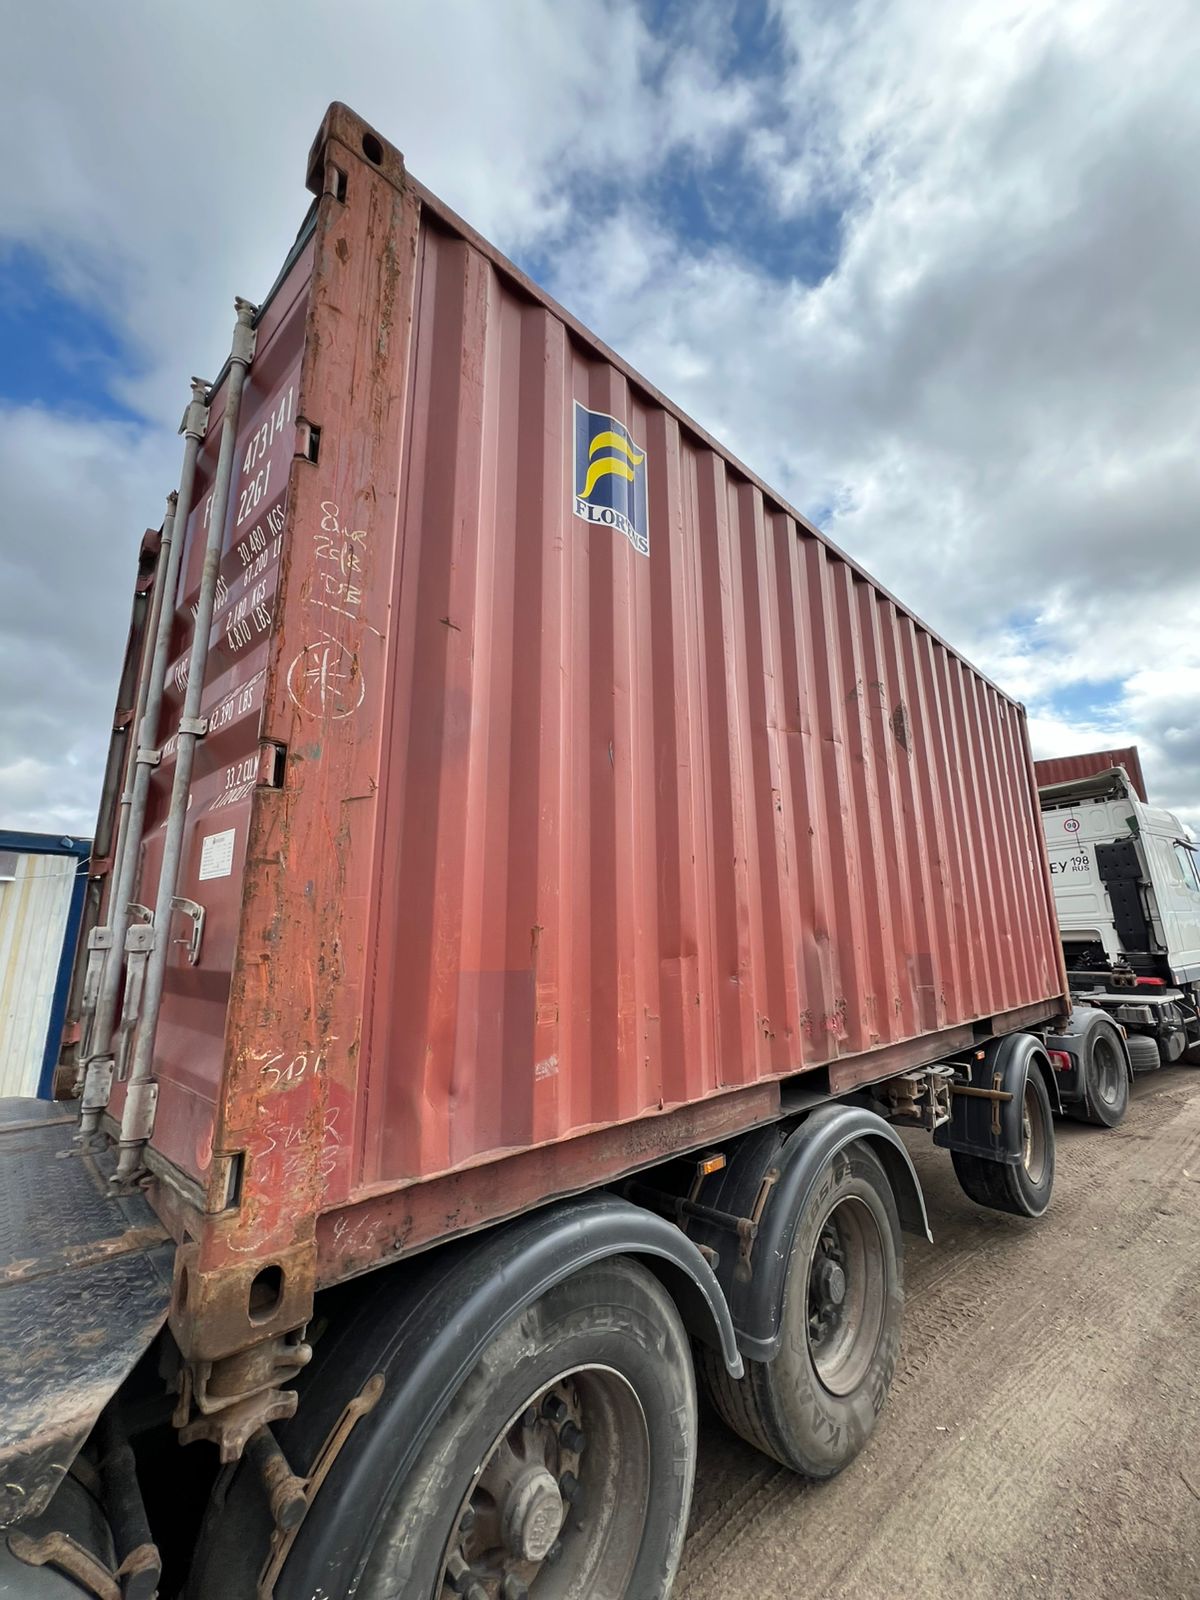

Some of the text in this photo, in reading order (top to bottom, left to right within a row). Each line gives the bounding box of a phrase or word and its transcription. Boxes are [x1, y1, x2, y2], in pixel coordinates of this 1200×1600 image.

[242, 386, 294, 474] 473141
[237, 460, 272, 527] 22G1
[237, 504, 285, 567] 30.480 KGS
[575, 501, 650, 554] FLORENS
[251, 602, 272, 633] LBS
[238, 686, 254, 715] LBS
[224, 763, 243, 790] 33.2
[1070, 855, 1089, 866] 198
